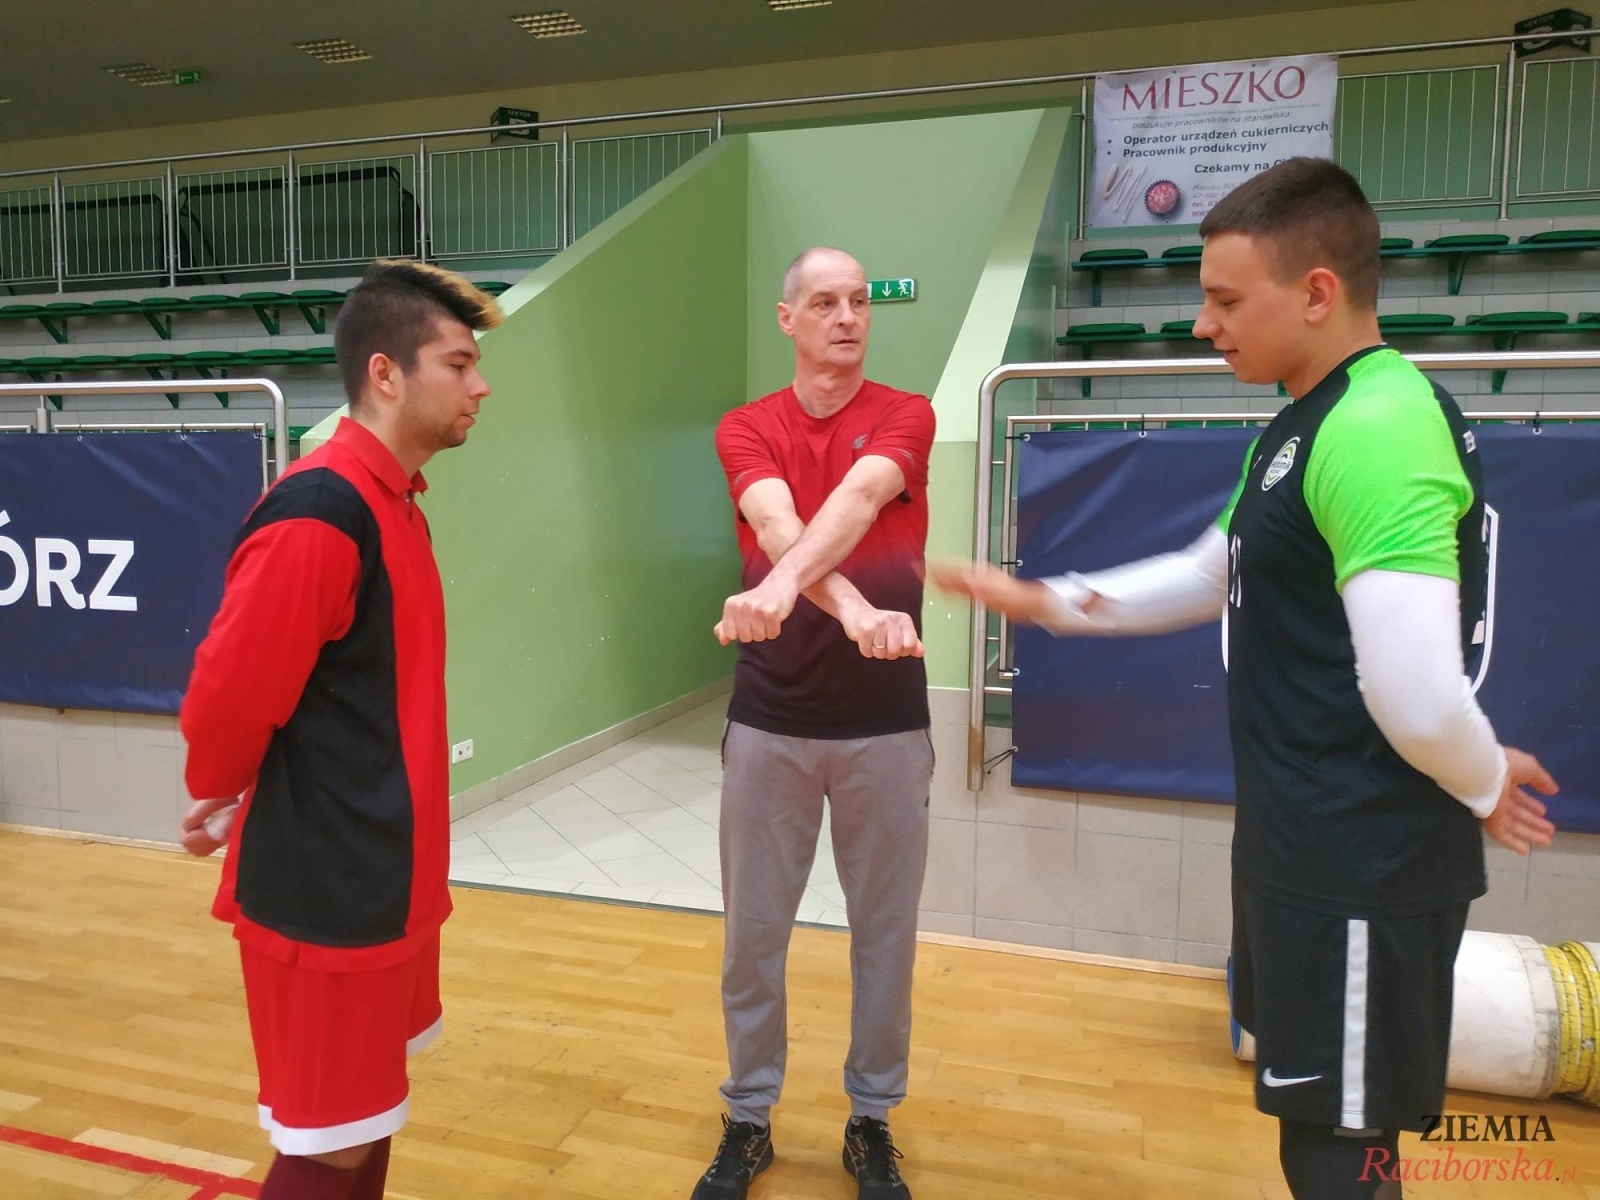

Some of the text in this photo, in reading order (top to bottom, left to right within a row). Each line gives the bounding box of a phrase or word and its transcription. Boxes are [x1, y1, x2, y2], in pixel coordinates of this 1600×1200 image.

[1122, 66, 1306, 111] MIESZKO
[1132, 119, 1173, 130] poszukuje
[1174, 113, 1229, 128] pracowników
[1231, 115, 1241, 124] na
[1244, 110, 1294, 123] stanowiska:
[1123, 122, 1329, 146] Operator urządzeń cukierniczych
[1123, 141, 1267, 158] Pracownik produkcyjny
[1194, 163, 1250, 173] Czekamy
[1254, 162, 1270, 171] na
